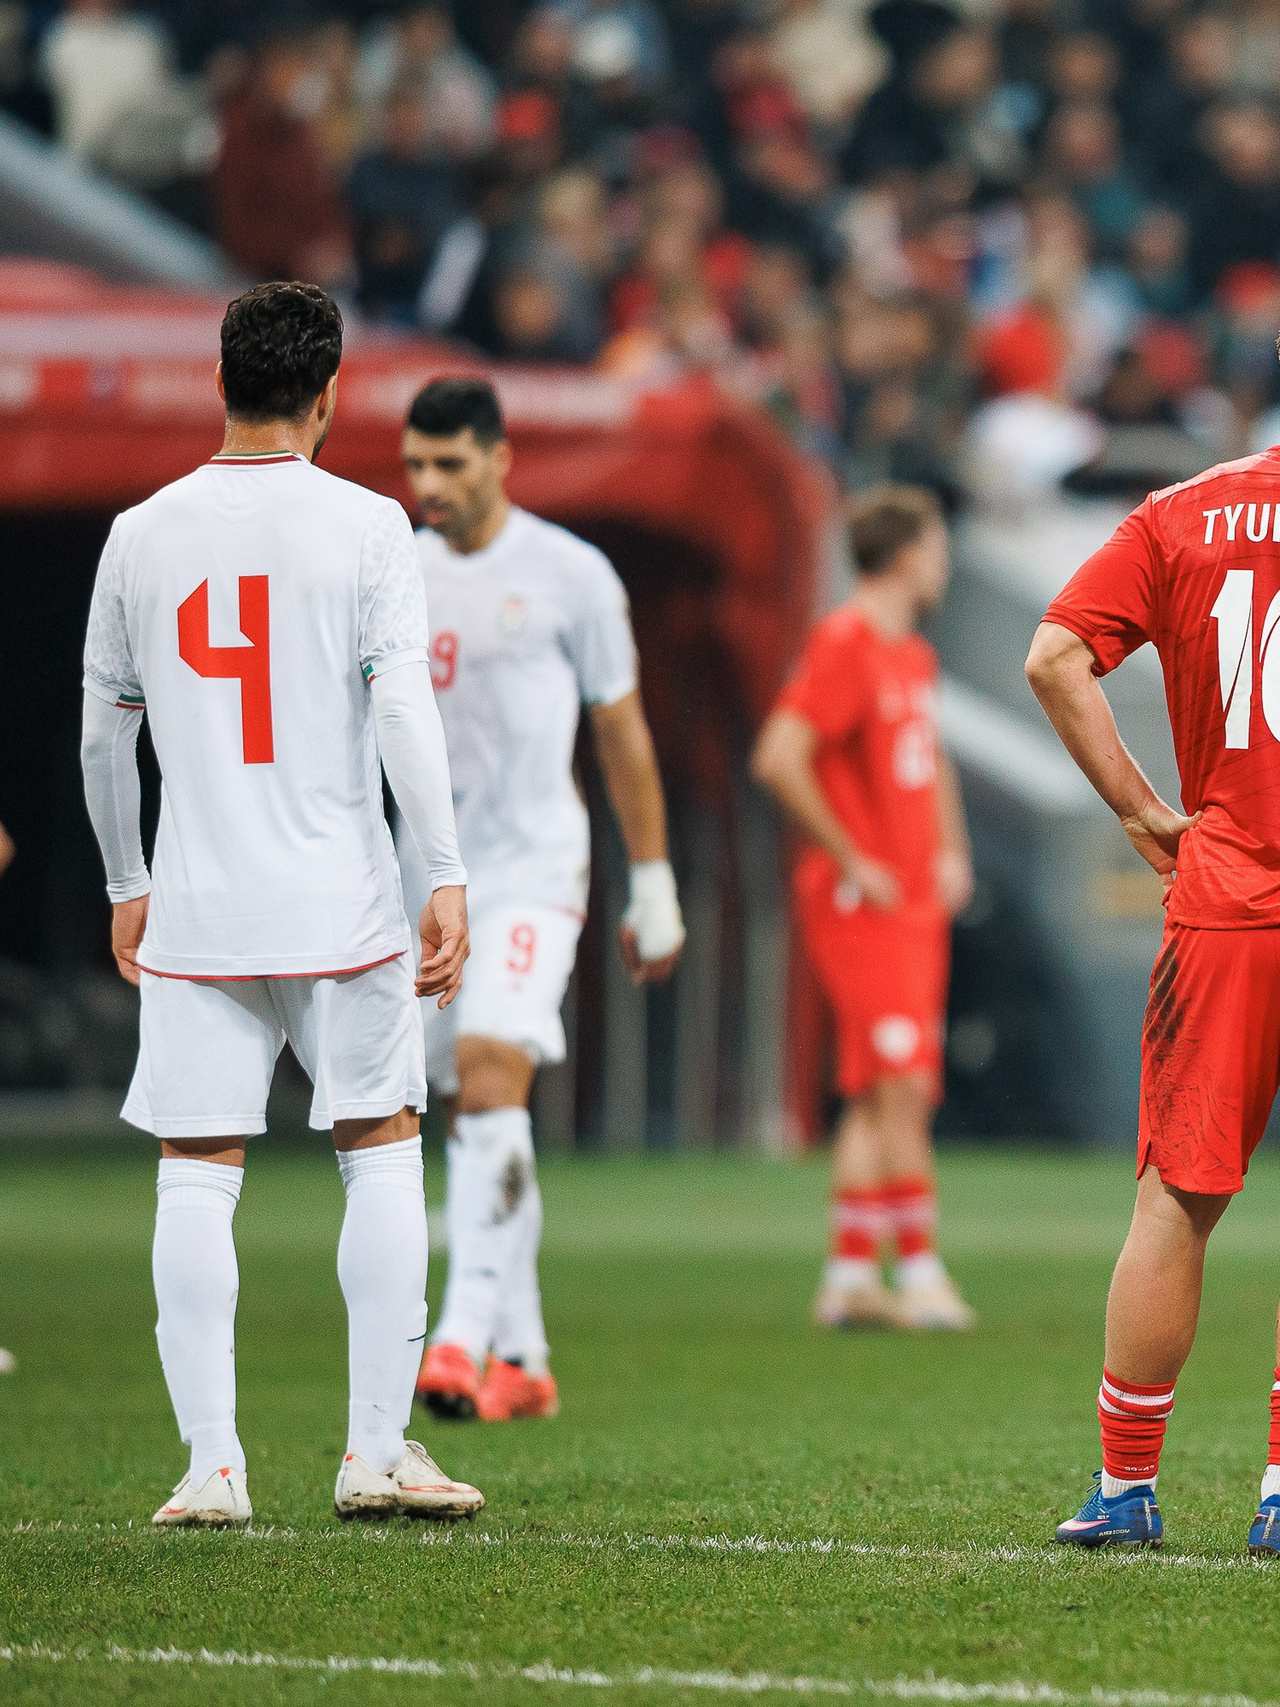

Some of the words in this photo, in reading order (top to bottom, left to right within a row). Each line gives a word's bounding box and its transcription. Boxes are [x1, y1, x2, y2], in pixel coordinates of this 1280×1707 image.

[177, 574, 275, 764] 4
[431, 630, 458, 692] 9
[507, 922, 537, 975] 9
